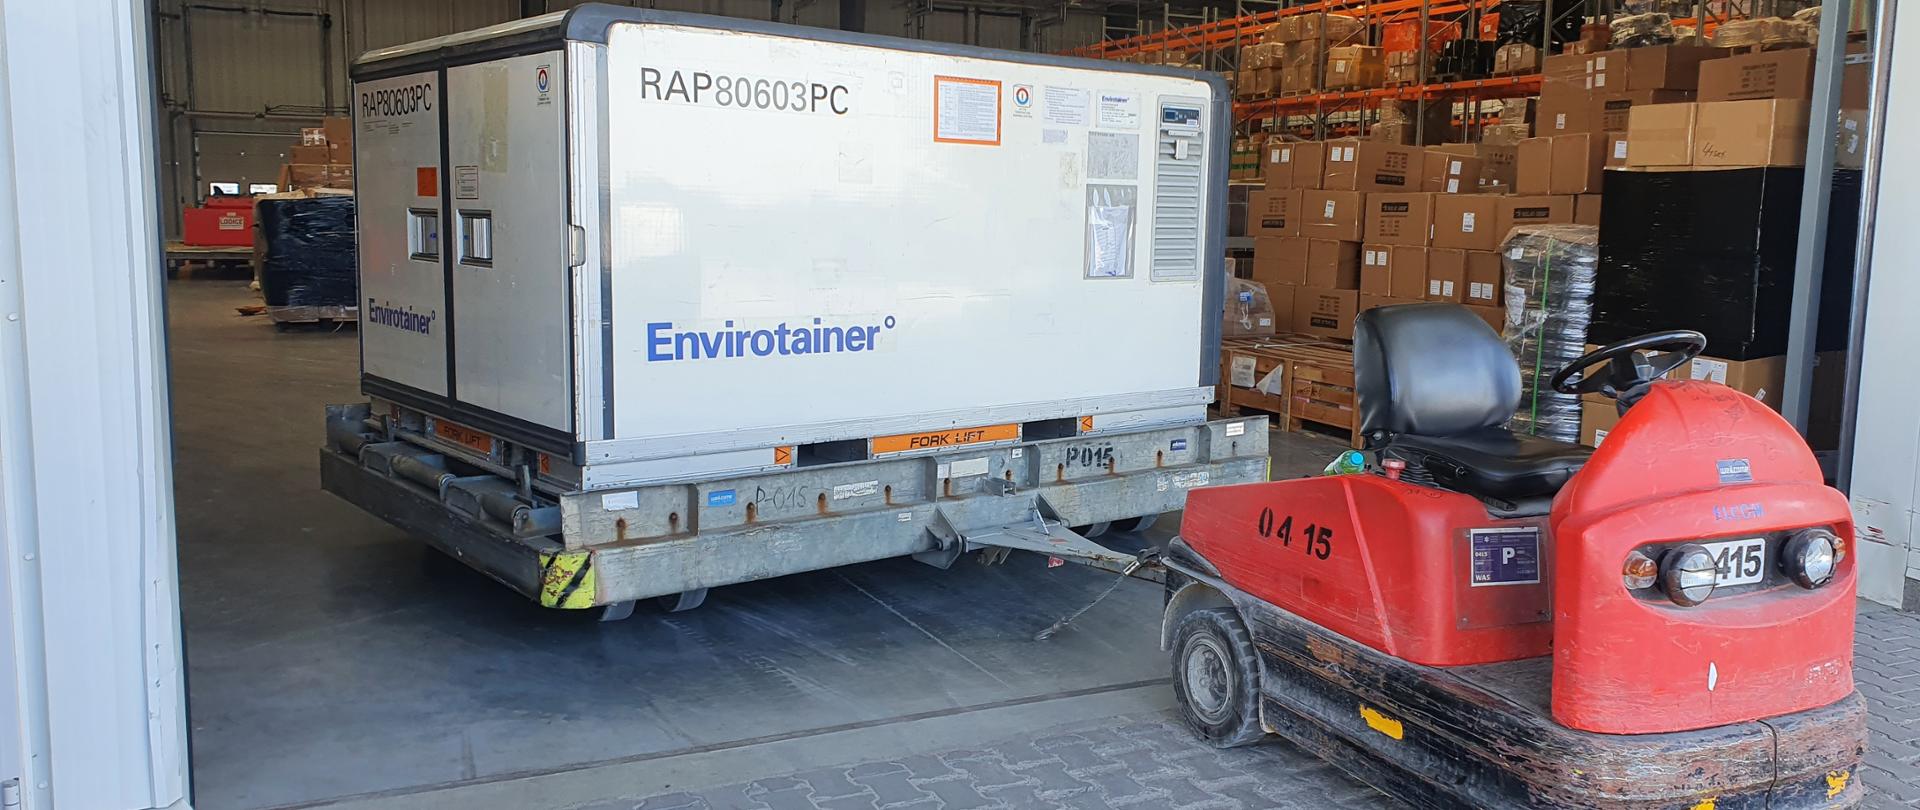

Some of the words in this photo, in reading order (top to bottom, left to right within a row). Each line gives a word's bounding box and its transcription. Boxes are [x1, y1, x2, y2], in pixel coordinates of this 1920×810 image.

[362, 83, 431, 117] RAP80603PC
[641, 67, 848, 115] RAP80603PC
[910, 433, 950, 448] FORK
[955, 430, 984, 443] LIFT
[1066, 446, 1114, 470] P015
[1502, 547, 1516, 565] P
